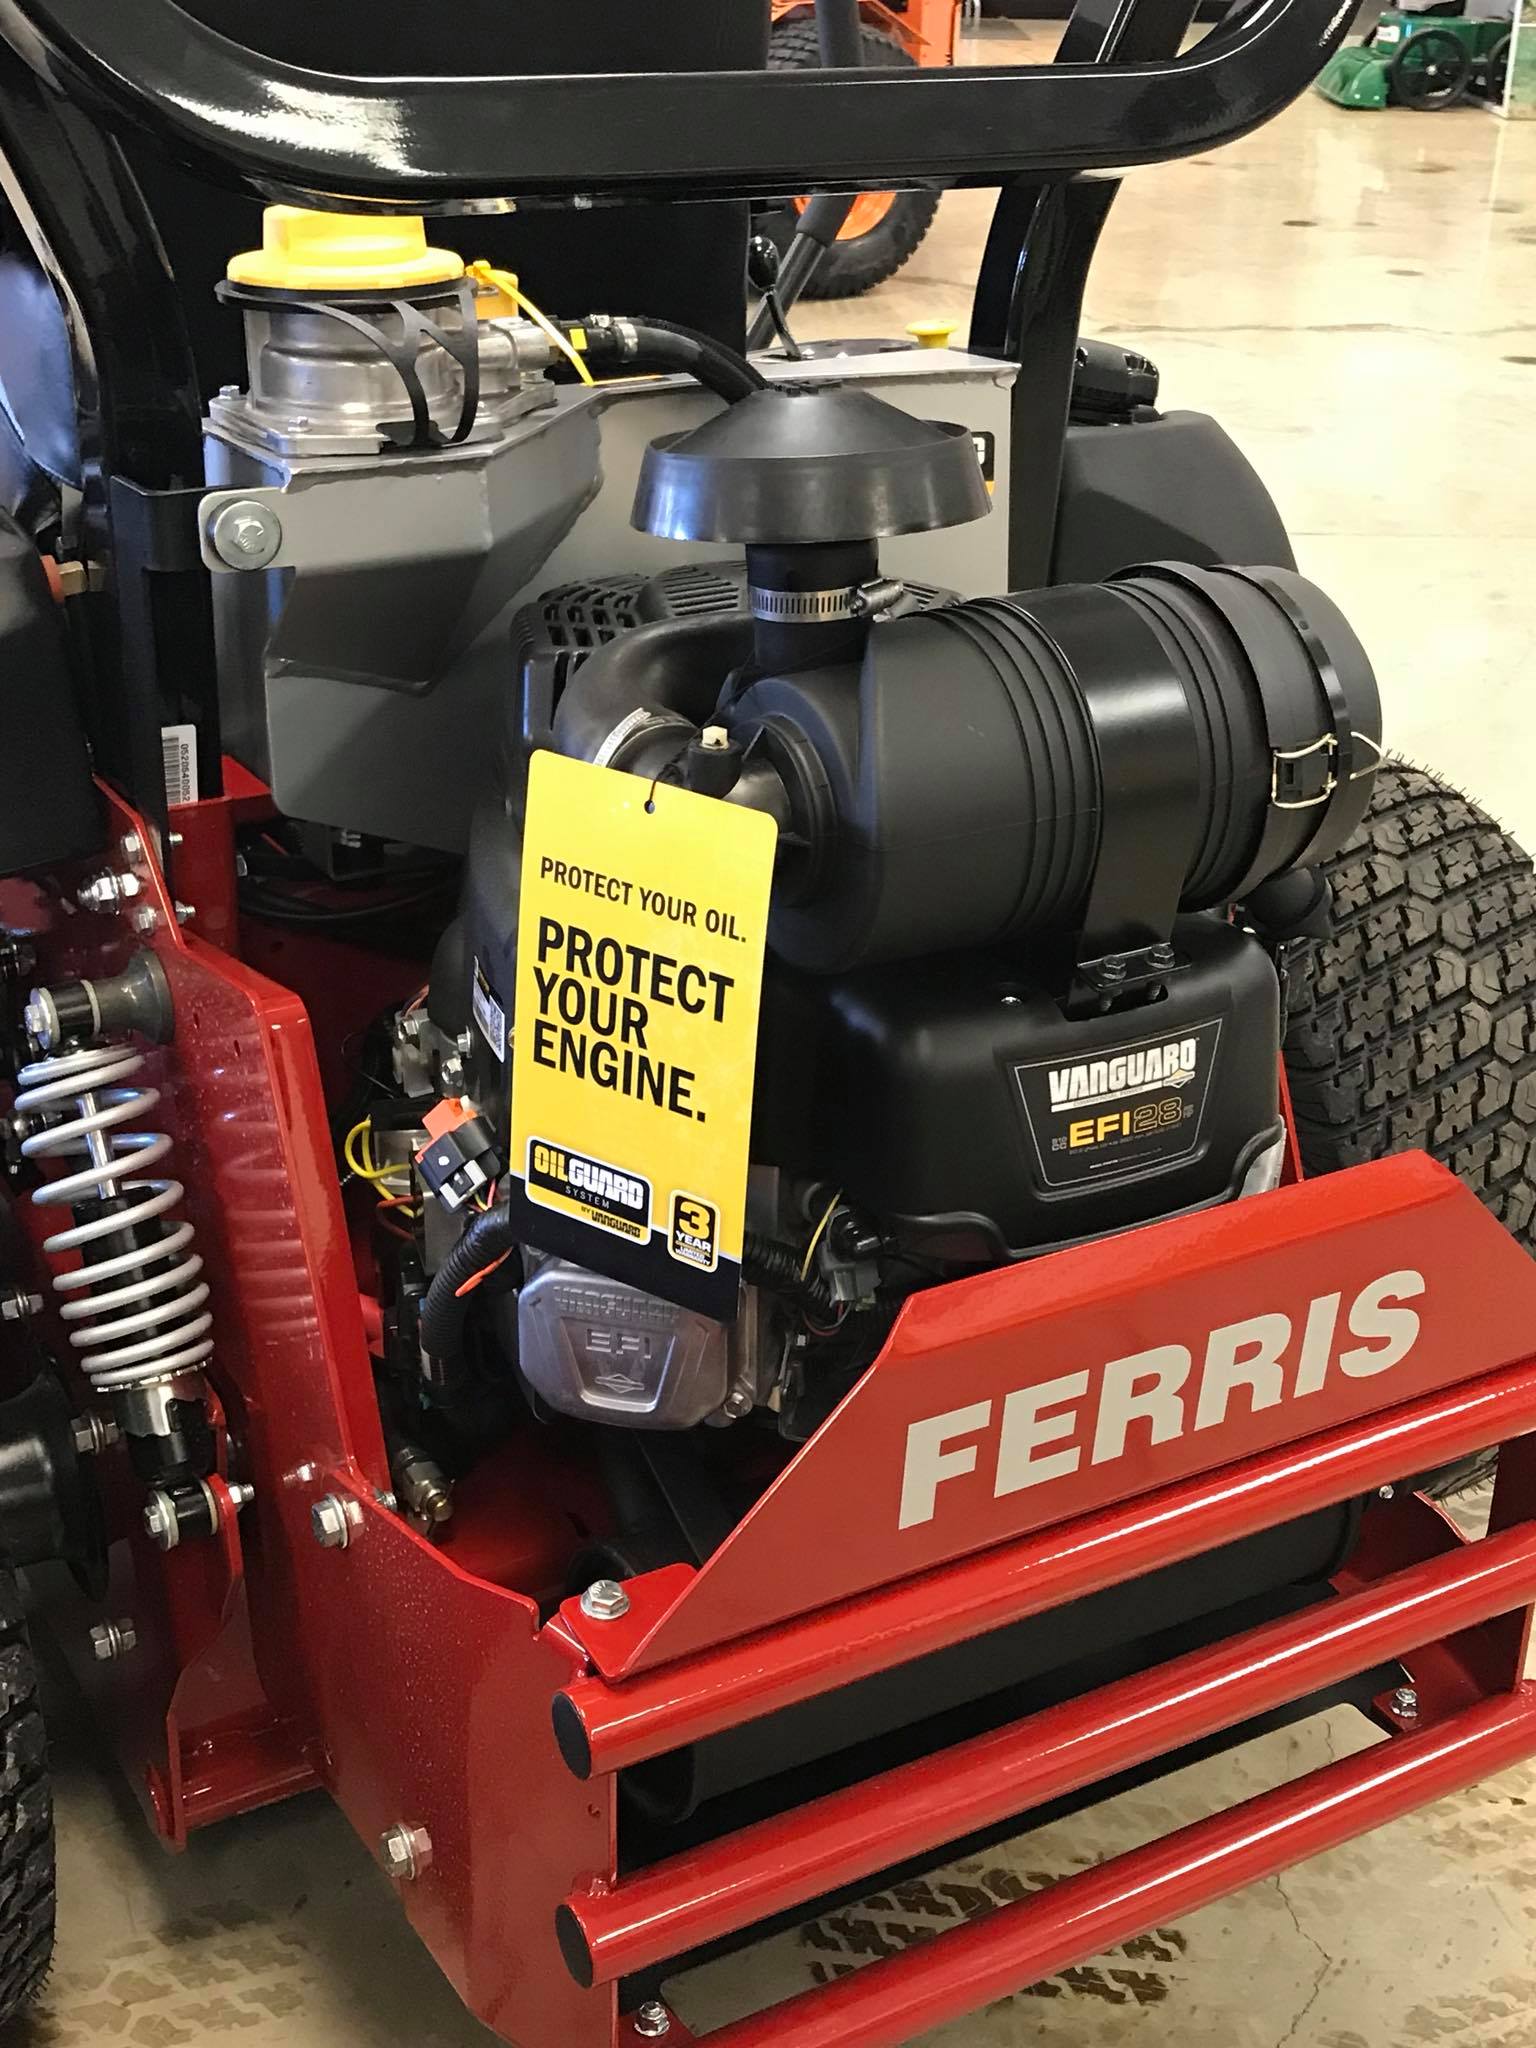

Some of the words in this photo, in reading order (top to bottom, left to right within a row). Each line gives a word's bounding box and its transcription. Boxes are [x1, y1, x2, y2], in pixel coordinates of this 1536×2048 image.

[541, 856, 633, 905] PROTECT
[639, 886, 697, 927] YOUR
[705, 909, 747, 943] OIL.
[537, 916, 735, 1023] PROTECT
[533, 966, 649, 1050] YOUR
[533, 1018, 706, 1123] ENGINE.
[1048, 1038, 1197, 1104] VANGUARD
[565, 1185, 610, 1209] SYSTEM
[679, 1201, 711, 1240] 3
[675, 1230, 712, 1253] YEAR
[585, 1328, 652, 1360] EFI
[898, 1270, 1426, 1531] FERRIS
